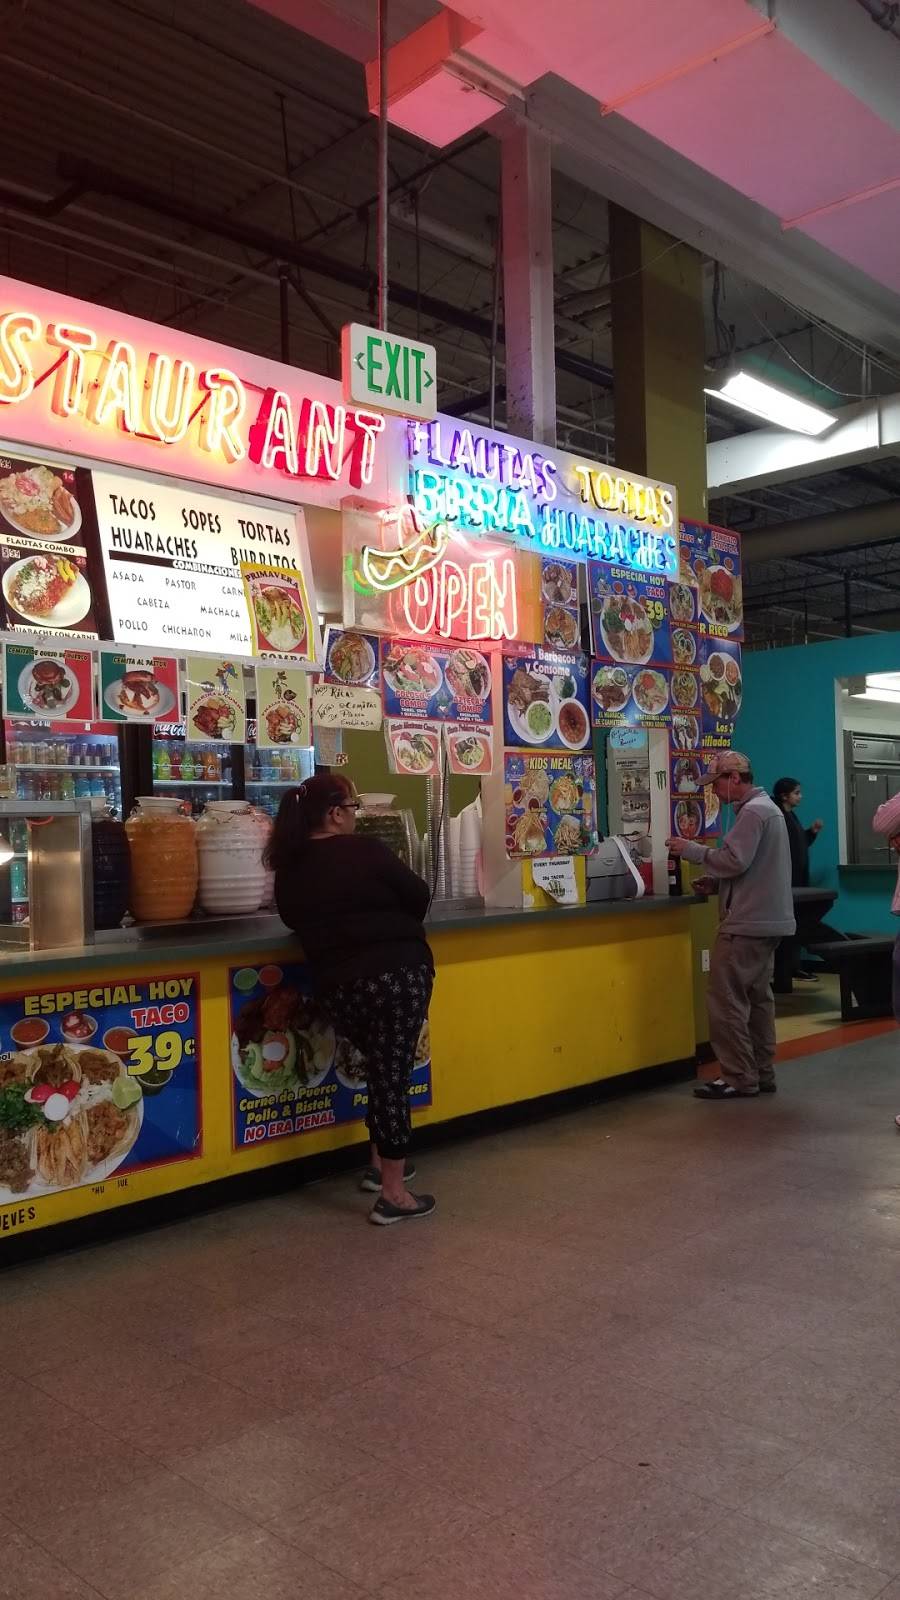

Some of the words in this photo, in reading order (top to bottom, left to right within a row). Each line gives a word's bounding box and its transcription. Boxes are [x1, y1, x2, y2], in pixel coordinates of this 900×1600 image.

[366, 336, 425, 404] EXIT
[0, 312, 386, 487] STAURANT
[408, 420, 557, 501] FLAUTAS
[575, 466, 673, 528] TORTAS
[109, 494, 156, 521] TACOS
[181, 508, 221, 534] SOPES
[238, 519, 291, 546] TORTAS
[414, 470, 536, 538] BIRRIA
[541, 504, 677, 573] HUARACHES
[6, 537, 43, 548] FLAUTAS
[44, 544, 75, 553] COMBO
[111, 526, 198, 559] HUARACHES
[230, 547, 297, 571] BURRITOS
[112, 571, 144, 583] ASADA
[165, 578, 197, 590] PASTOR
[244, 569, 299, 589] PRIMAVERA
[610, 568, 648, 583] ESPECIAL
[649, 575, 666, 586] HOY
[403, 559, 518, 640] OPEN
[646, 586, 666, 598] TACO
[137, 597, 170, 609] CABEZA
[200, 606, 241, 618] MACHACA
[118, 619, 148, 631] POLLO
[162, 625, 212, 638] CHICHARON
[708, 624, 729, 637] RICO
[533, 661, 570, 676] Consome
[538, 649, 576, 664] Barbacoa
[529, 757, 548, 770] KIDS
[550, 757, 572, 770] MEAL
[24, 985, 142, 1016] ESPECIAL
[149, 978, 193, 1001] HOY
[131, 1002, 190, 1029] TACO
[127, 1031, 195, 1076] 39¢
[239, 1094, 276, 1112] Carne
[278, 1089, 295, 1103] de
[298, 1083, 338, 1099] Puerco
[246, 1109, 278, 1124] Pollo
[282, 1105, 292, 1117] &
[296, 1097, 332, 1113] Bistek
[244, 1125, 266, 1143] NO
[268, 1119, 293, 1137] ERA
[295, 1110, 336, 1131] PENAL
